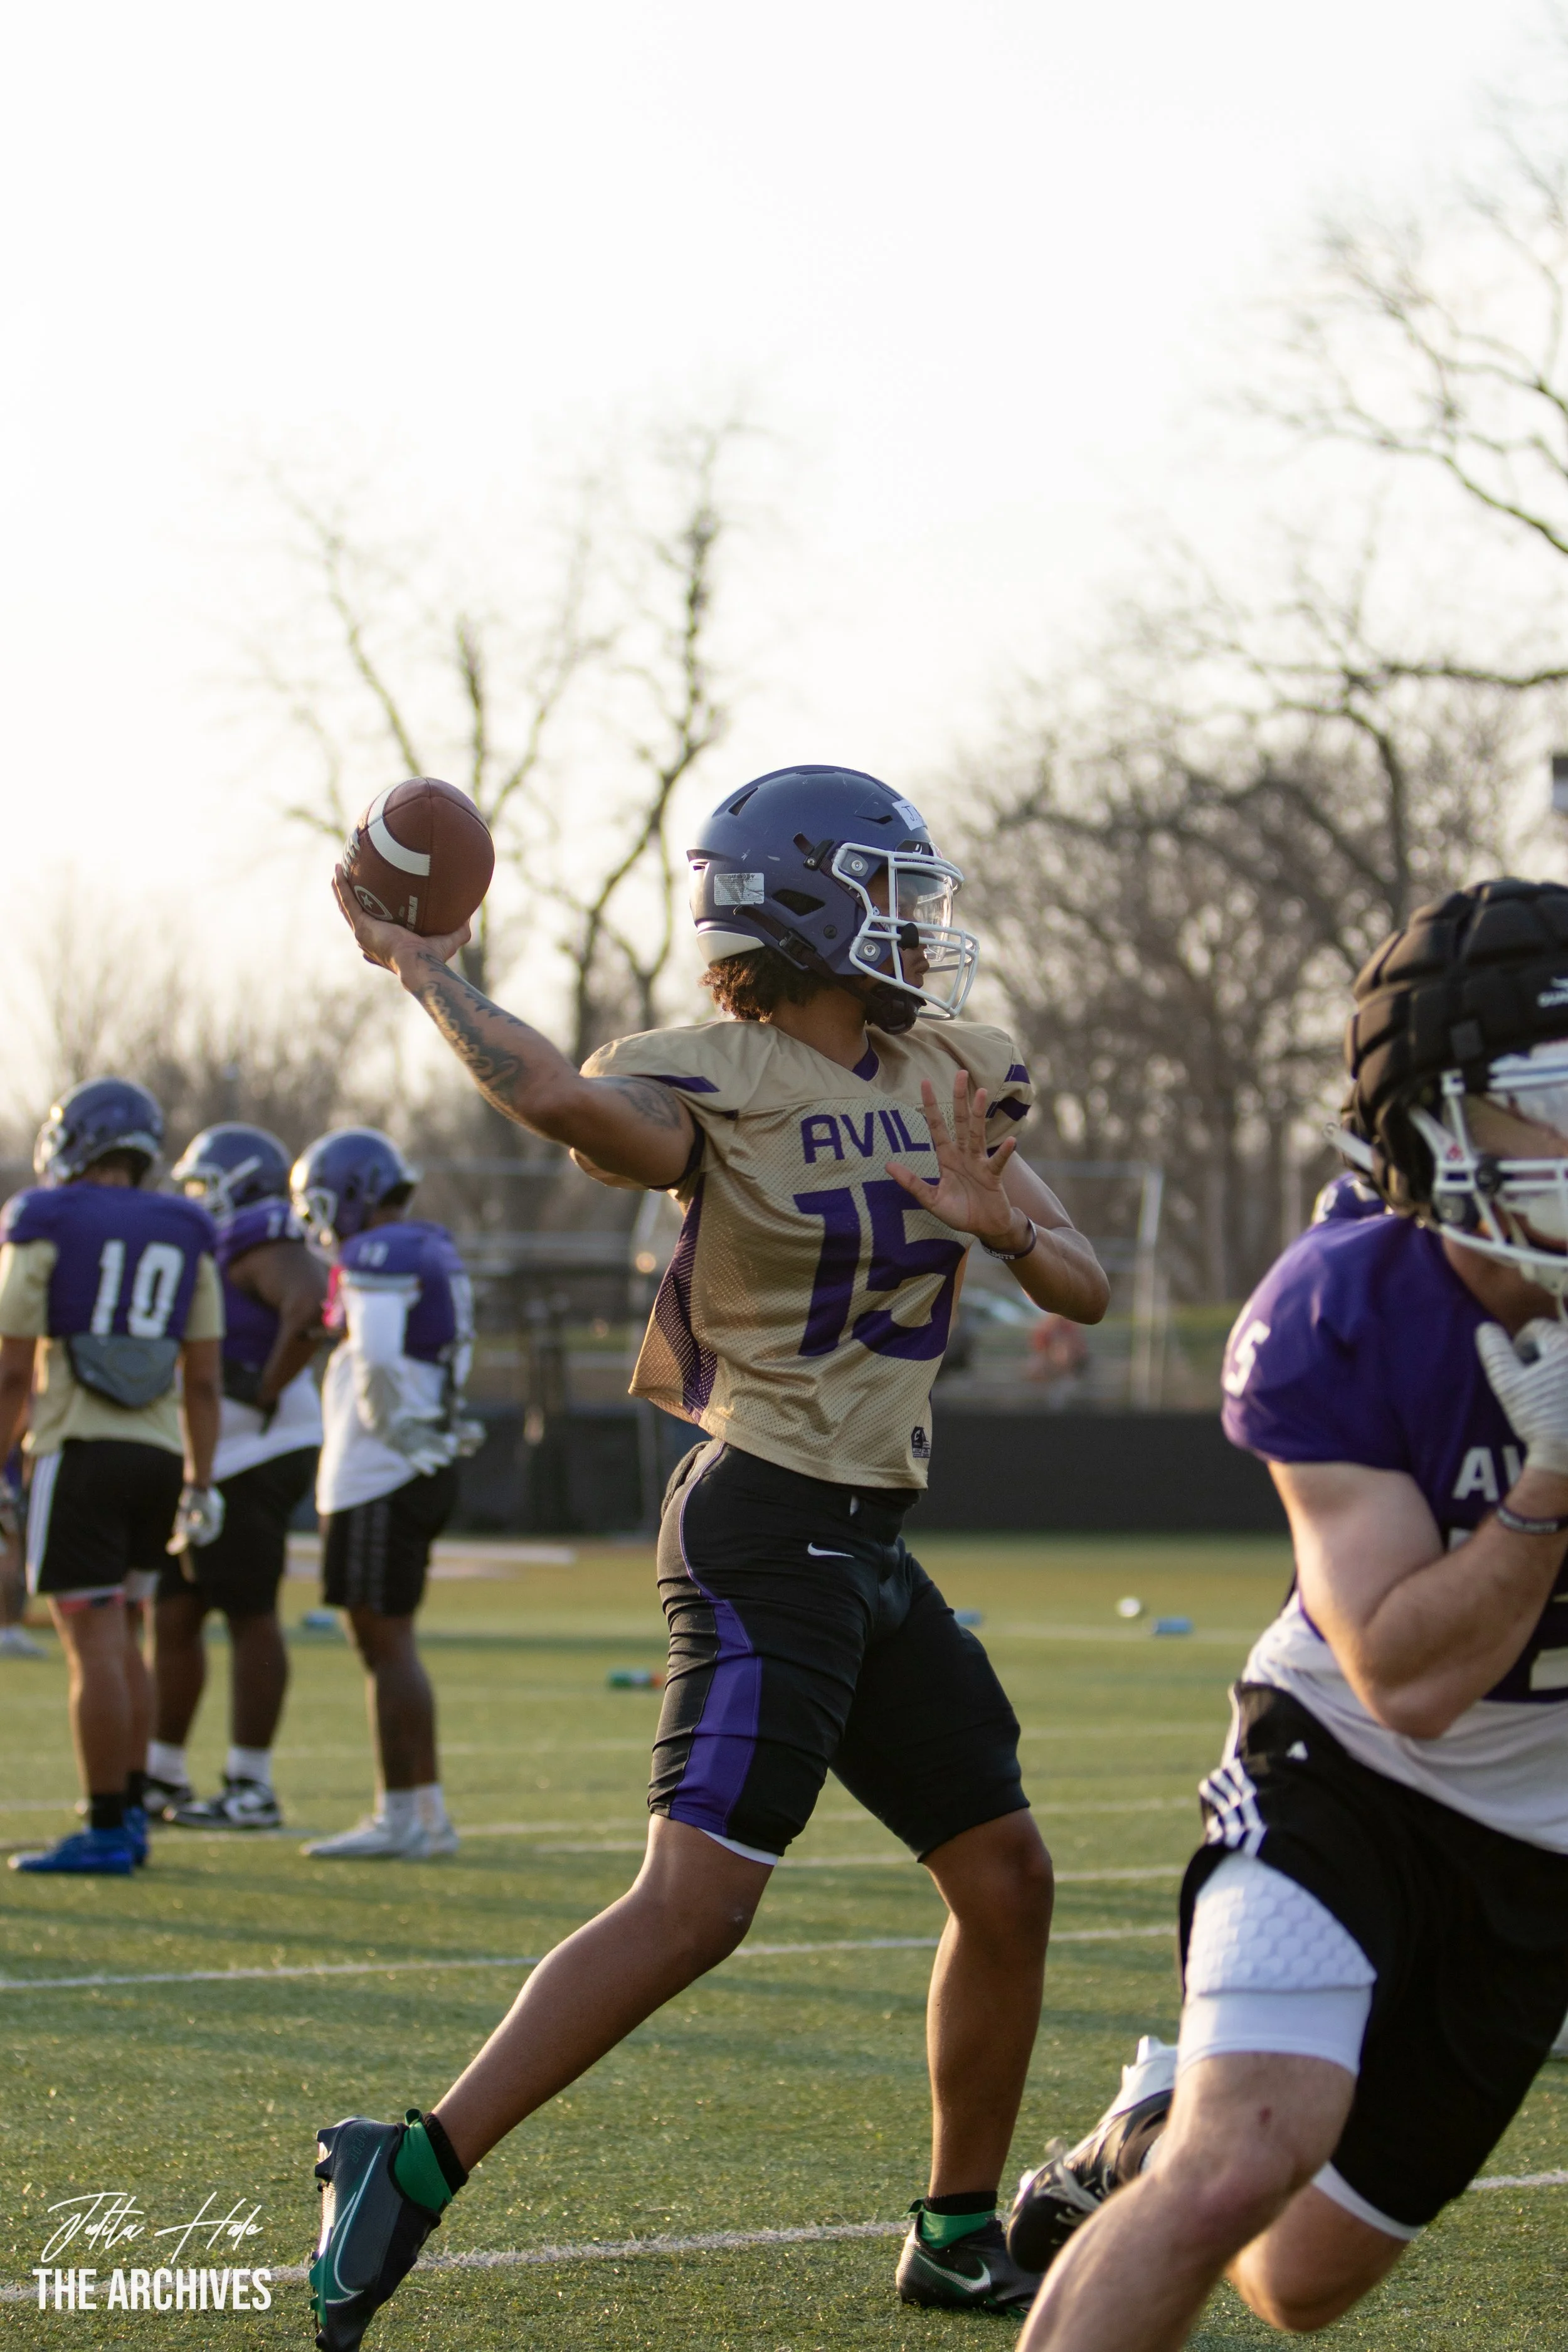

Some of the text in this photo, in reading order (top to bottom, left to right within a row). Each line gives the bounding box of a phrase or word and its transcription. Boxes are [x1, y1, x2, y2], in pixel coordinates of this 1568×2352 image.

[801, 1110, 936, 1164] AVIL
[90, 1238, 185, 1338] 10
[793, 1178, 966, 1361] 15
[1224, 1311, 1271, 1399] 5
